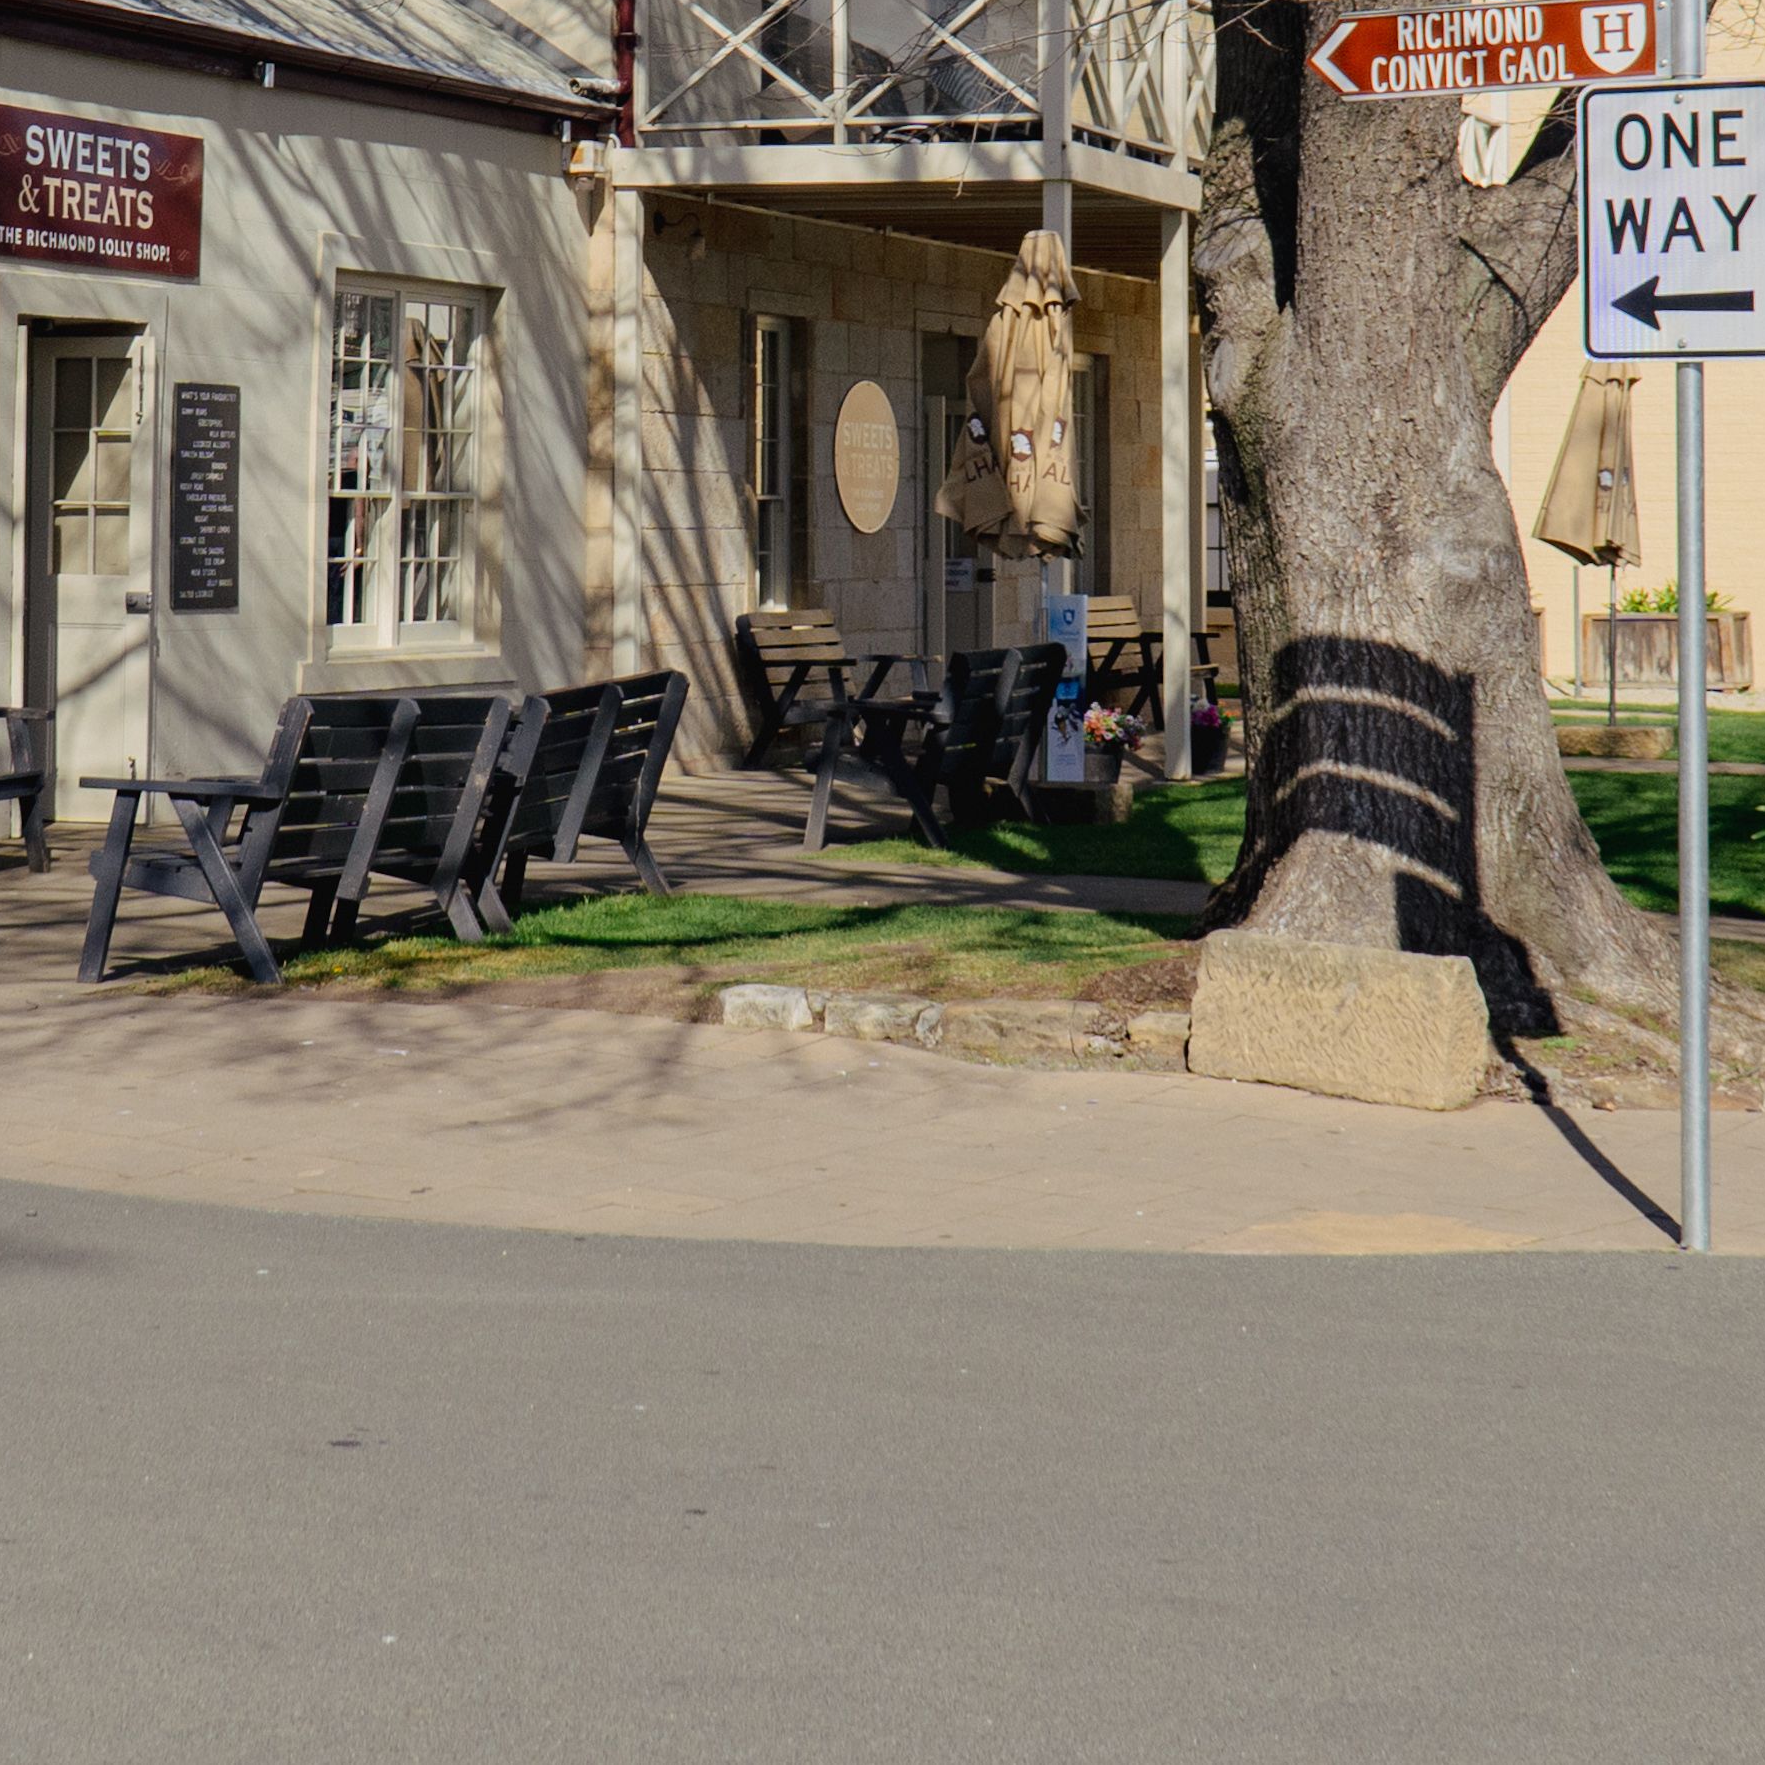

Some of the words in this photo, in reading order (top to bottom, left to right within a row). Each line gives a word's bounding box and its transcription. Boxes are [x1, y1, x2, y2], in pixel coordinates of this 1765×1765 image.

[1397, 5, 1544, 51] RICHMOND
[1592, 10, 1635, 55] H
[1371, 49, 1489, 94] CONVICT
[1499, 43, 1575, 84] GAOL
[25, 124, 151, 181] SWEETS
[1615, 109, 1747, 171] ONE
[43, 175, 154, 230] TREATS
[1605, 194, 1757, 255] WAY
[26, 228, 96, 253] RICHMOND
[99, 238, 134, 256] LOLLY
[136, 242, 171, 262] SHOP!
[843, 422, 893, 449] SWEETS
